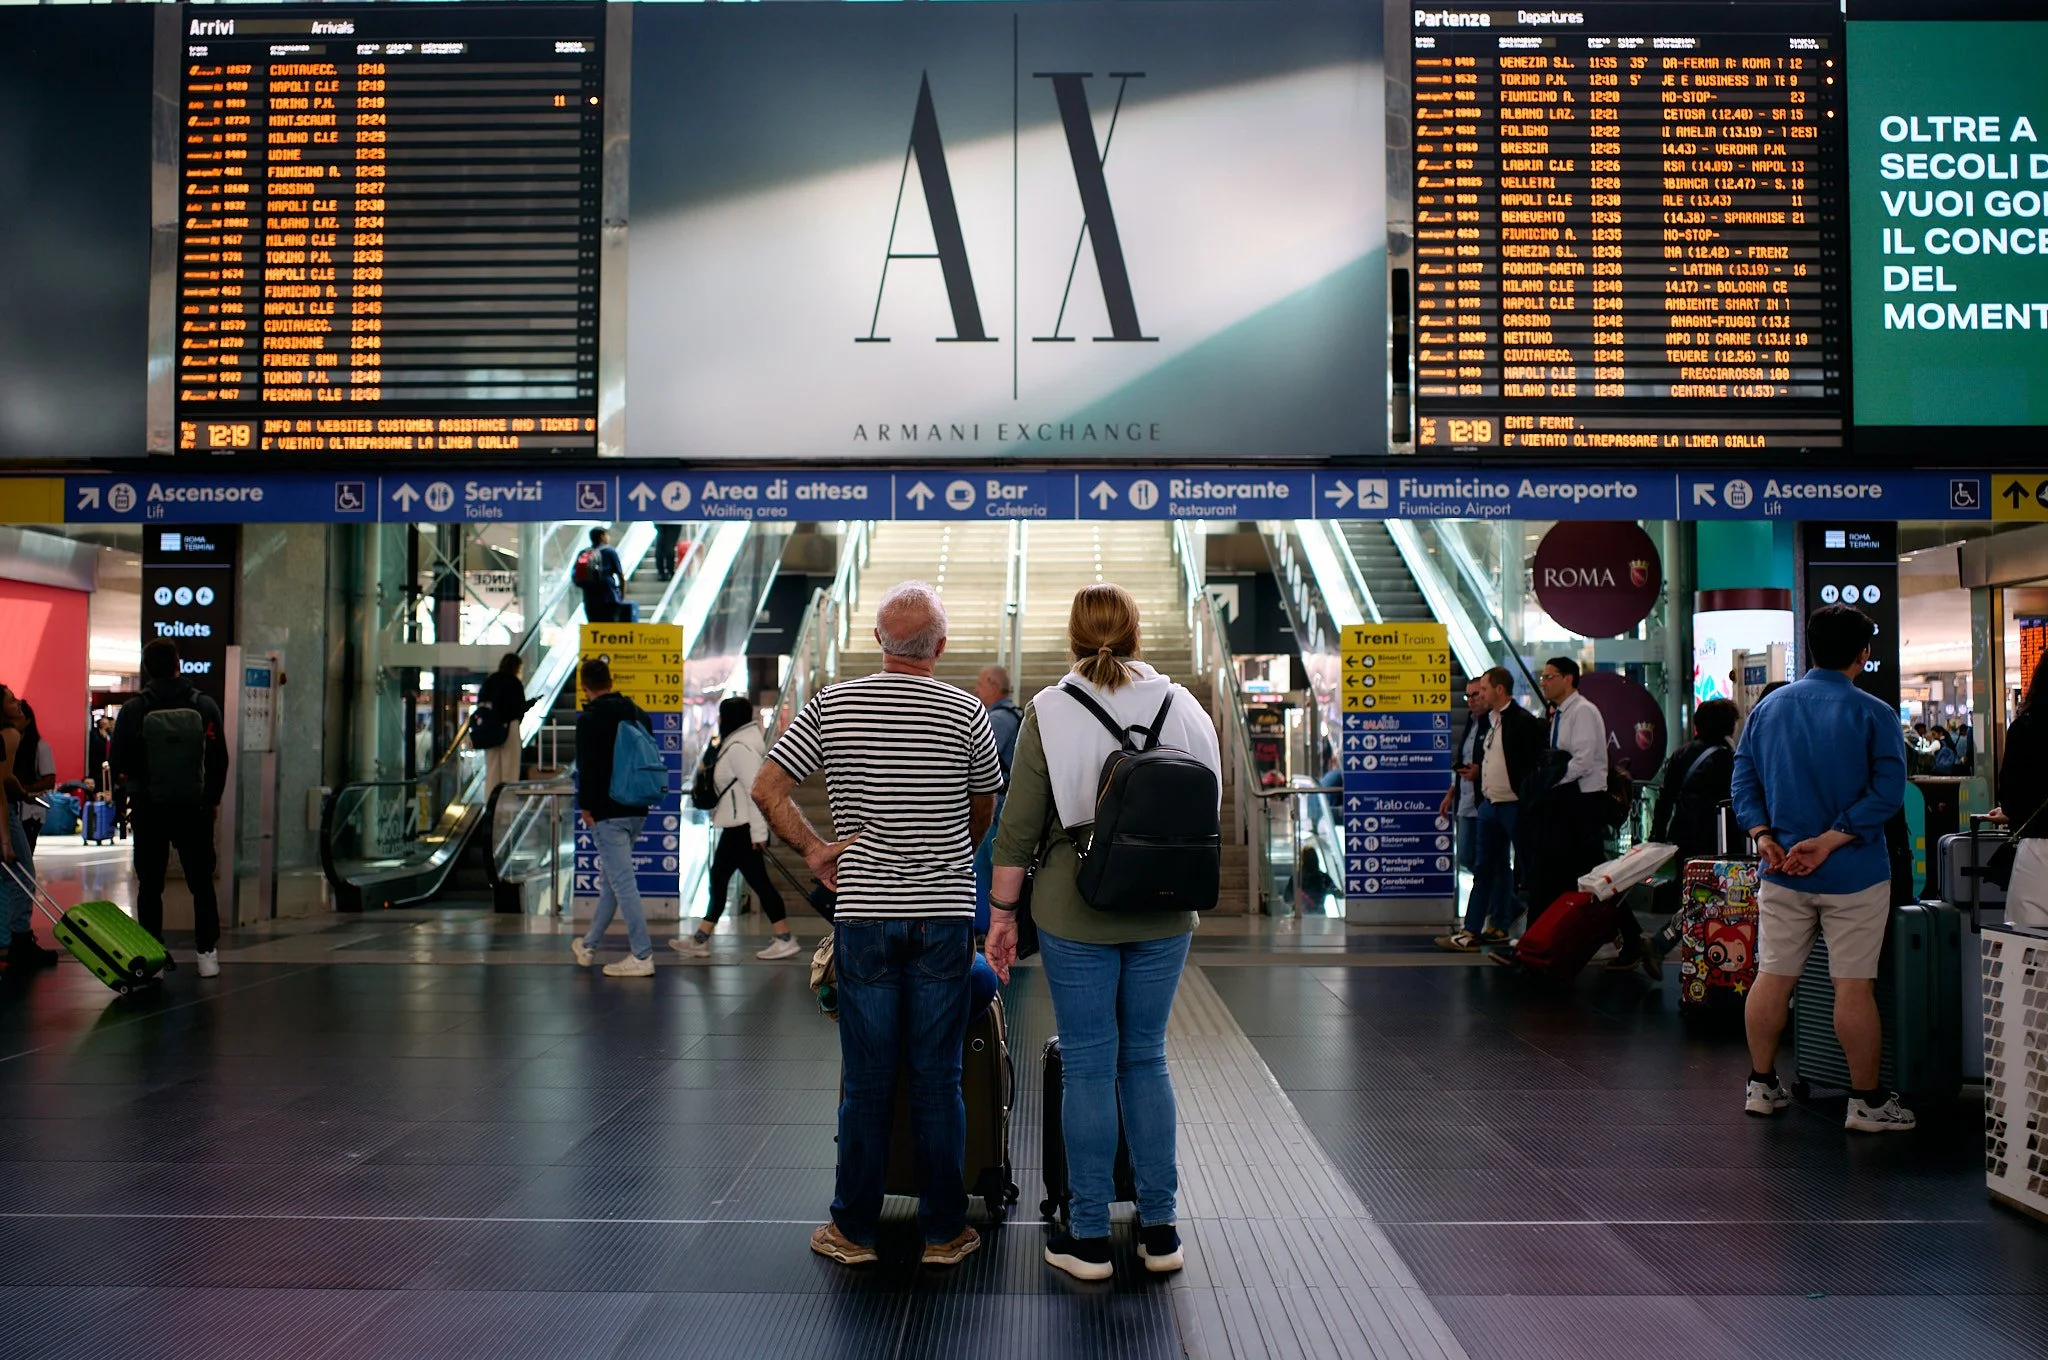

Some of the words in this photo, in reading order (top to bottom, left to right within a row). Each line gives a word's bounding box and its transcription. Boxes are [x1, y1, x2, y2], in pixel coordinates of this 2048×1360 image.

[1415, 10, 1490, 26] Partenze
[1518, 10, 1583, 26] Departures
[190, 19, 234, 36] Arrivi
[312, 21, 354, 34] Arrivals
[1500, 57, 1547, 68] VENEZIA
[1589, 57, 1618, 68] 11:35
[1742, 57, 1770, 69] ROMA
[1789, 57, 1802, 69] 12
[1501, 74, 1540, 85] TORINO
[1695, 74, 1749, 86] BUSINESS
[1790, 74, 1797, 86] 9
[270, 98, 308, 109] TORINO
[554, 95, 566, 106] 11
[1501, 91, 1557, 102] FIUMICINO
[1790, 91, 1805, 103] 23
[1501, 108, 1543, 120] ALBANO
[1790, 108, 1803, 120] 15
[1501, 125, 1548, 137] FOLIGNO
[1676, 126, 1716, 138] AMELIA
[1880, 115, 2000, 142] OLTRE
[2010, 116, 2037, 142] A
[268, 149, 301, 160] UDINE
[1501, 142, 1548, 154] BRESCIA
[1590, 142, 1620, 154] 12:25
[1716, 144, 1758, 155] VERONA
[1880, 153, 2018, 179] SECOLI
[268, 183, 314, 195] CASSINO
[1501, 177, 1555, 189] VELLETRI
[1792, 178, 1804, 190] 18
[1880, 190, 1973, 216] VUOI
[1984, 190, 2048, 216] GO
[1502, 211, 1565, 223] BENEVENTO
[1591, 211, 1621, 223] 12:35
[1724, 212, 1786, 224] SPARANISE
[1792, 212, 1805, 224] 21
[1883, 228, 1915, 254] IL
[1503, 263, 1584, 275] FORMIA-GAETA
[1682, 264, 1723, 276] LATINA
[1793, 264, 1806, 276] 16
[1884, 266, 1957, 292] DEL
[1503, 315, 1551, 327] CASSINO
[1671, 316, 1756, 328] ANAGNI-FIUGGI
[1884, 303, 2048, 330] MOMENT
[263, 337, 324, 349] FROSINONE
[1504, 332, 1552, 344] NETTUNO
[263, 354, 310, 366] FIRENZE
[1681, 368, 1763, 380] FRECCIAROSSA
[262, 388, 312, 401] PESCARA
[1504, 384, 1545, 397] MILANO
[1671, 385, 1727, 397] CENTRALE
[264, 420, 291, 433] INFO
[317, 419, 372, 432] WEBSITES
[377, 419, 434, 432] CUSTOMER
[439, 418, 507, 432] ASSISTANCE
[540, 418, 578, 431] TICKET
[1504, 416, 1534, 429] ENTE
[1540, 416, 1574, 429] FERMI
[208, 425, 250, 447] 12:19
[854, 424, 978, 441] ARMANI
[998, 423, 1160, 441] EXCHANGE
[1448, 420, 1492, 443] 12:19
[278, 437, 324, 449] VIETATO
[329, 436, 412, 449] OLTREPASSARE
[418, 436, 433, 449] LA
[439, 436, 472, 449] LINEA
[1520, 434, 1567, 447] VIETATO
[1574, 434, 1658, 447] OLTREPASSARE
[1664, 435, 1679, 448] LA
[1684, 435, 1718, 448] LINEA
[1725, 435, 1765, 448] GIALLA
[146, 484, 262, 502] Ascensore
[465, 481, 542, 501] Servizi
[702, 480, 758, 499] Area
[766, 480, 788, 499] di
[795, 482, 867, 499] attesa
[986, 481, 1027, 498] Bar
[1169, 478, 1289, 499] Ristorante
[1400, 478, 1509, 498] Fiumicino
[1517, 480, 1637, 502] Aeroporto
[1764, 480, 1882, 498] Ascensore
[147, 506, 164, 518] Lift
[464, 504, 502, 518] Toilets
[702, 504, 755, 520] Waiting
[759, 507, 788, 517] area
[986, 504, 1046, 517] Cafeteria
[1169, 503, 1237, 515] Restaurant
[1400, 502, 1462, 515] Fiumicino
[1466, 502, 1511, 518] Airport
[1765, 503, 1781, 515] Lift
[184, 543, 215, 551] TERMINI
[1544, 568, 1615, 588] ROMA
[154, 620, 211, 637] Toilets
[591, 630, 633, 644] Treni
[638, 633, 670, 645] Trains
[1354, 631, 1398, 644] Treni
[1403, 633, 1435, 645] Trains
[179, 659, 211, 673] loor
[1380, 735, 1411, 743] Servizi
[1404, 801, 1424, 810] Club
